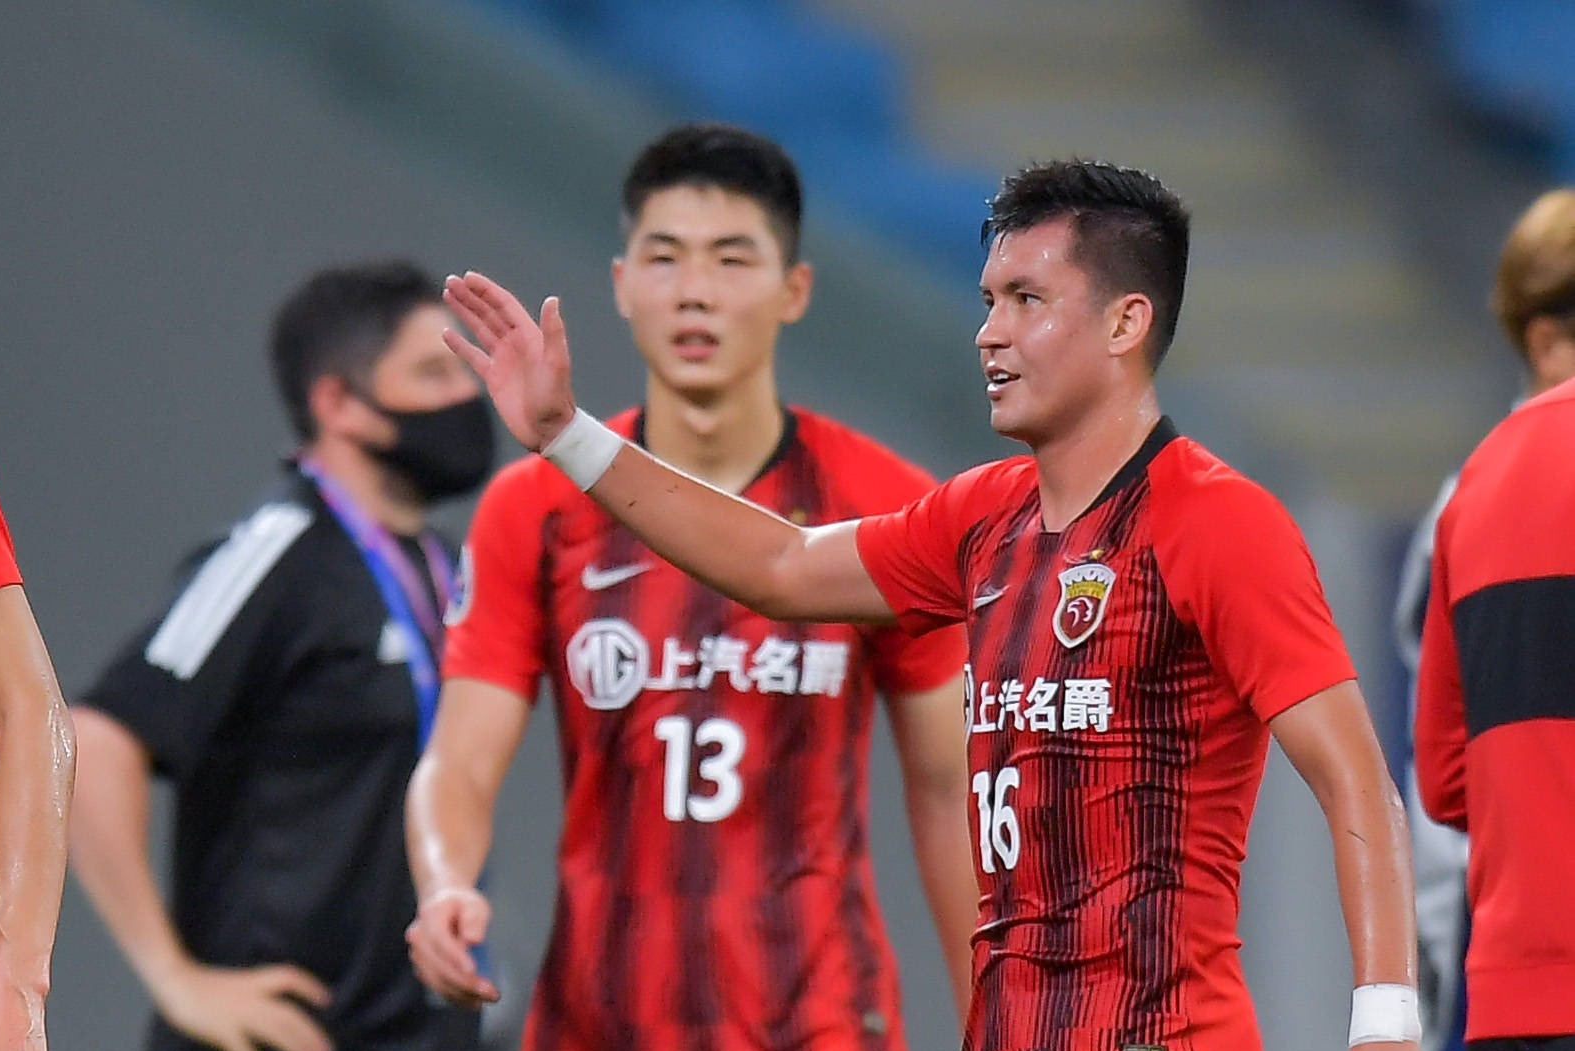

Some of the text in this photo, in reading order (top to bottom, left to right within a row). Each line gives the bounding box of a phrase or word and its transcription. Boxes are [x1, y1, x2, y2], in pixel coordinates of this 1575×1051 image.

[570, 623, 645, 707] MG
[971, 676, 1114, 733] 上汽名爵
[654, 715, 746, 823] 13
[972, 766, 1021, 874] 16
